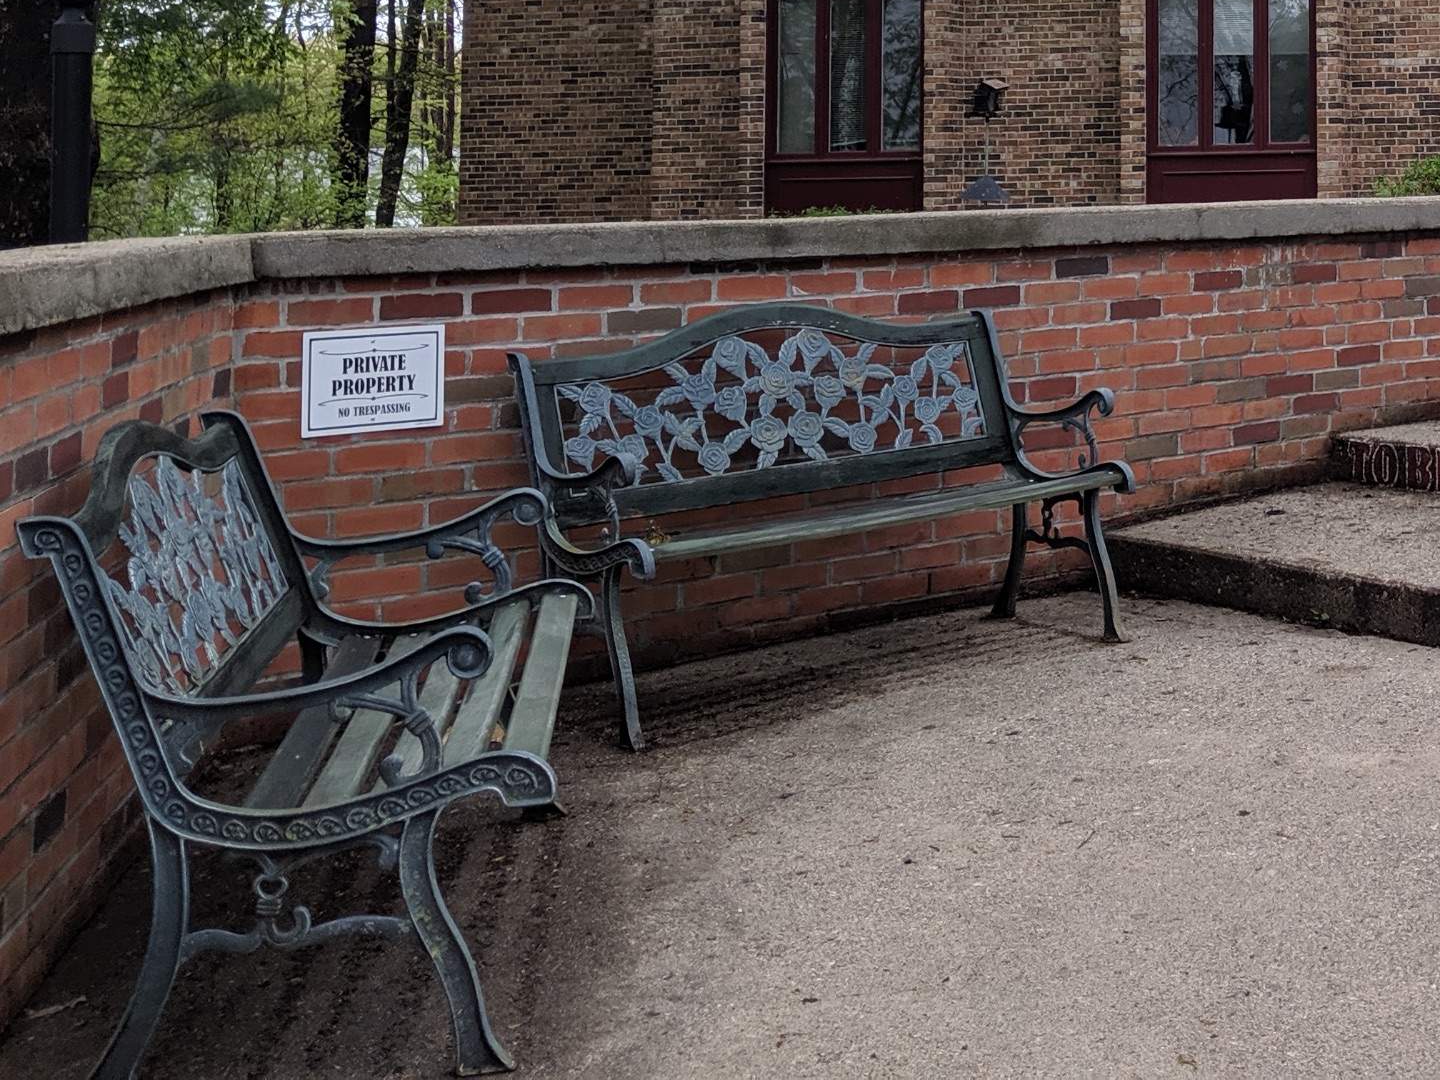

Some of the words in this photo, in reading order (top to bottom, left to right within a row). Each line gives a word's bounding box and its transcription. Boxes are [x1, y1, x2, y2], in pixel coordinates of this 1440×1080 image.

[342, 354, 407, 375] PRIVATE
[331, 374, 416, 397] PROPERTY
[338, 407, 350, 418] NO
[354, 402, 411, 417] TRESPASSING
